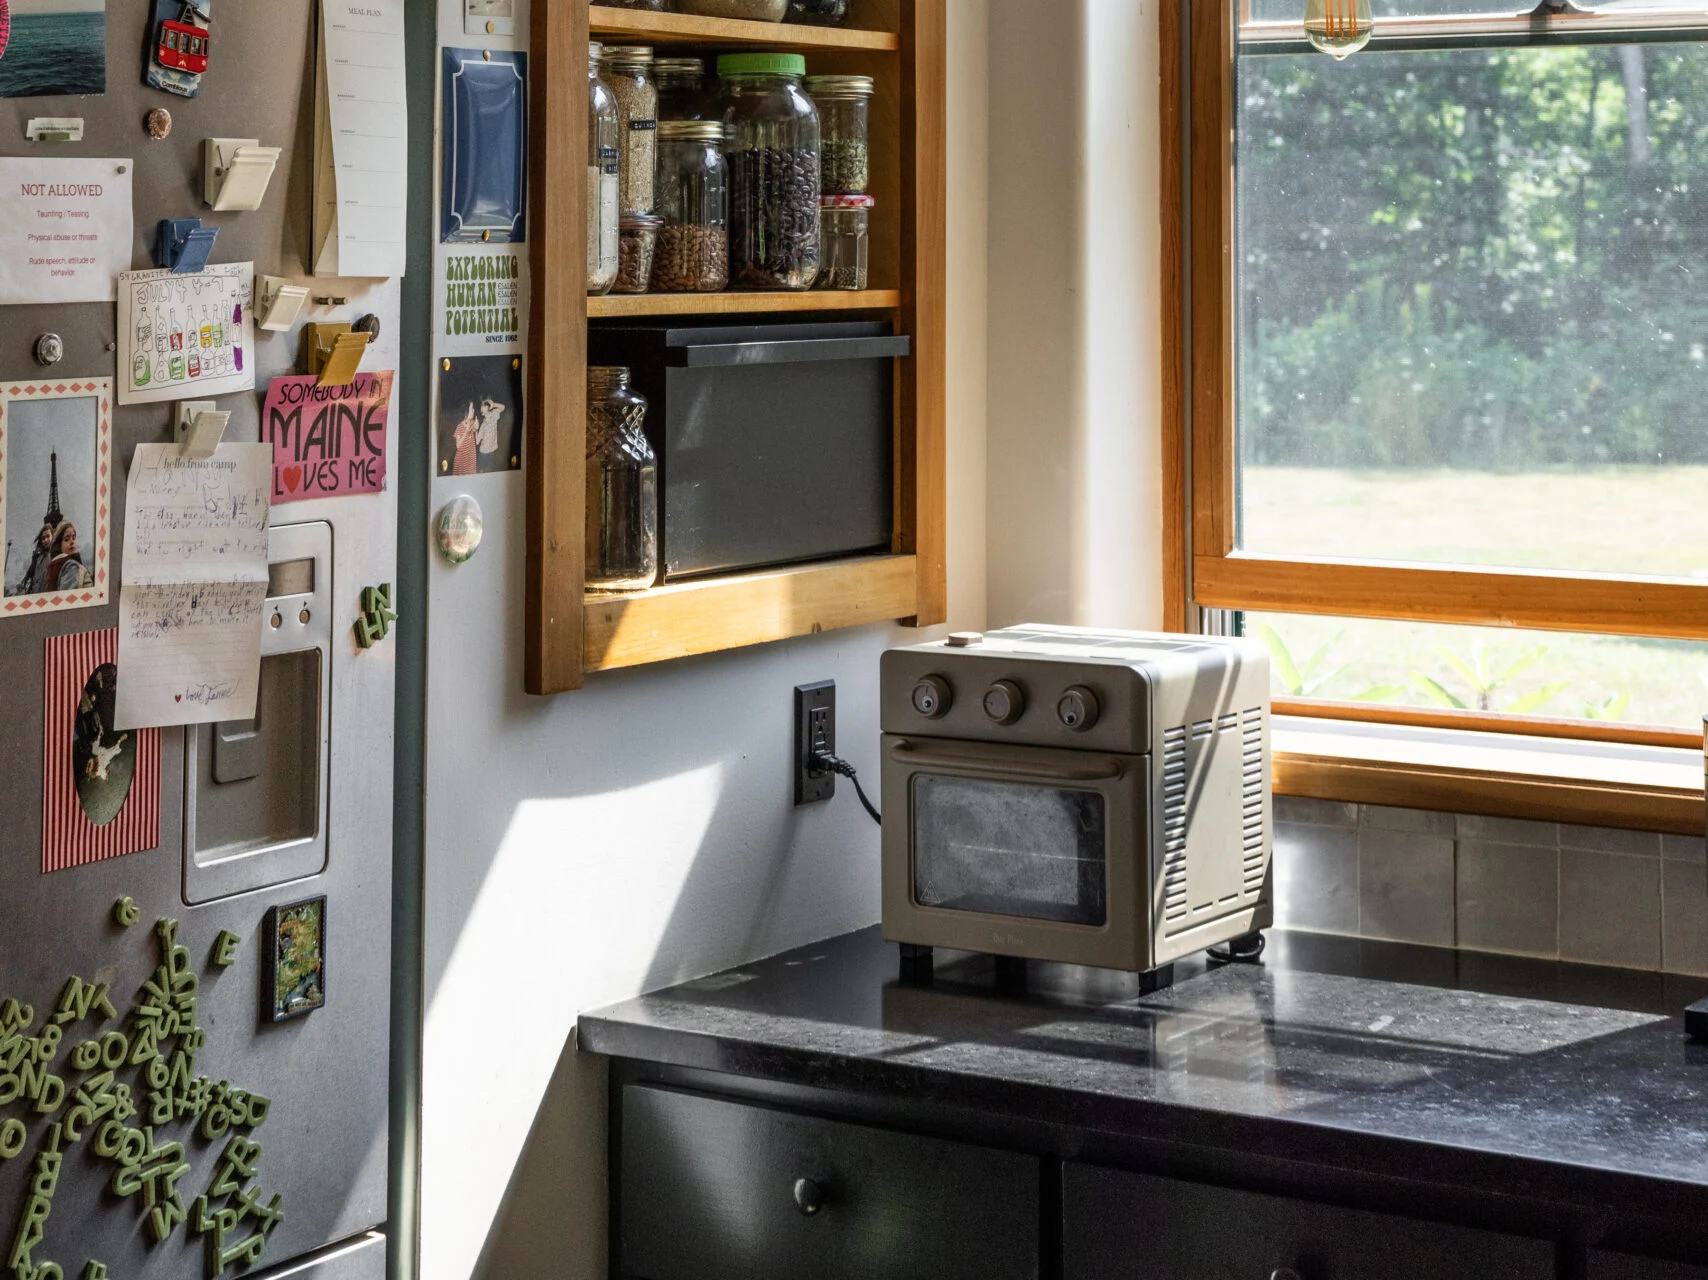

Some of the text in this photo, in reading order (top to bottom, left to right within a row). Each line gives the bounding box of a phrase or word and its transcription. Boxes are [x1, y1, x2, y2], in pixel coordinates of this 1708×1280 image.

[348, 7, 382, 17] MEAL PLAN
[21, 183, 103, 197] NOT ALLOWED
[27, 233, 53, 243] Physical
[54, 233, 71, 241] abuse
[29, 257, 45, 265] Rude
[51, 269, 75, 277] behavior
[446, 255, 518, 281] EXPLORING
[136, 280, 175, 304] JULY
[446, 282, 496, 308] HUMAN
[446, 307, 518, 335] POTENTIAL
[485, 334, 504, 343] SINCE
[278, 378, 383, 404] SOMEBODY IN
[270, 398, 385, 464] MAINE
[163, 457, 237, 473] hello from camp
[349, 457, 376, 489] ME
[214, 930, 241, 966] E
